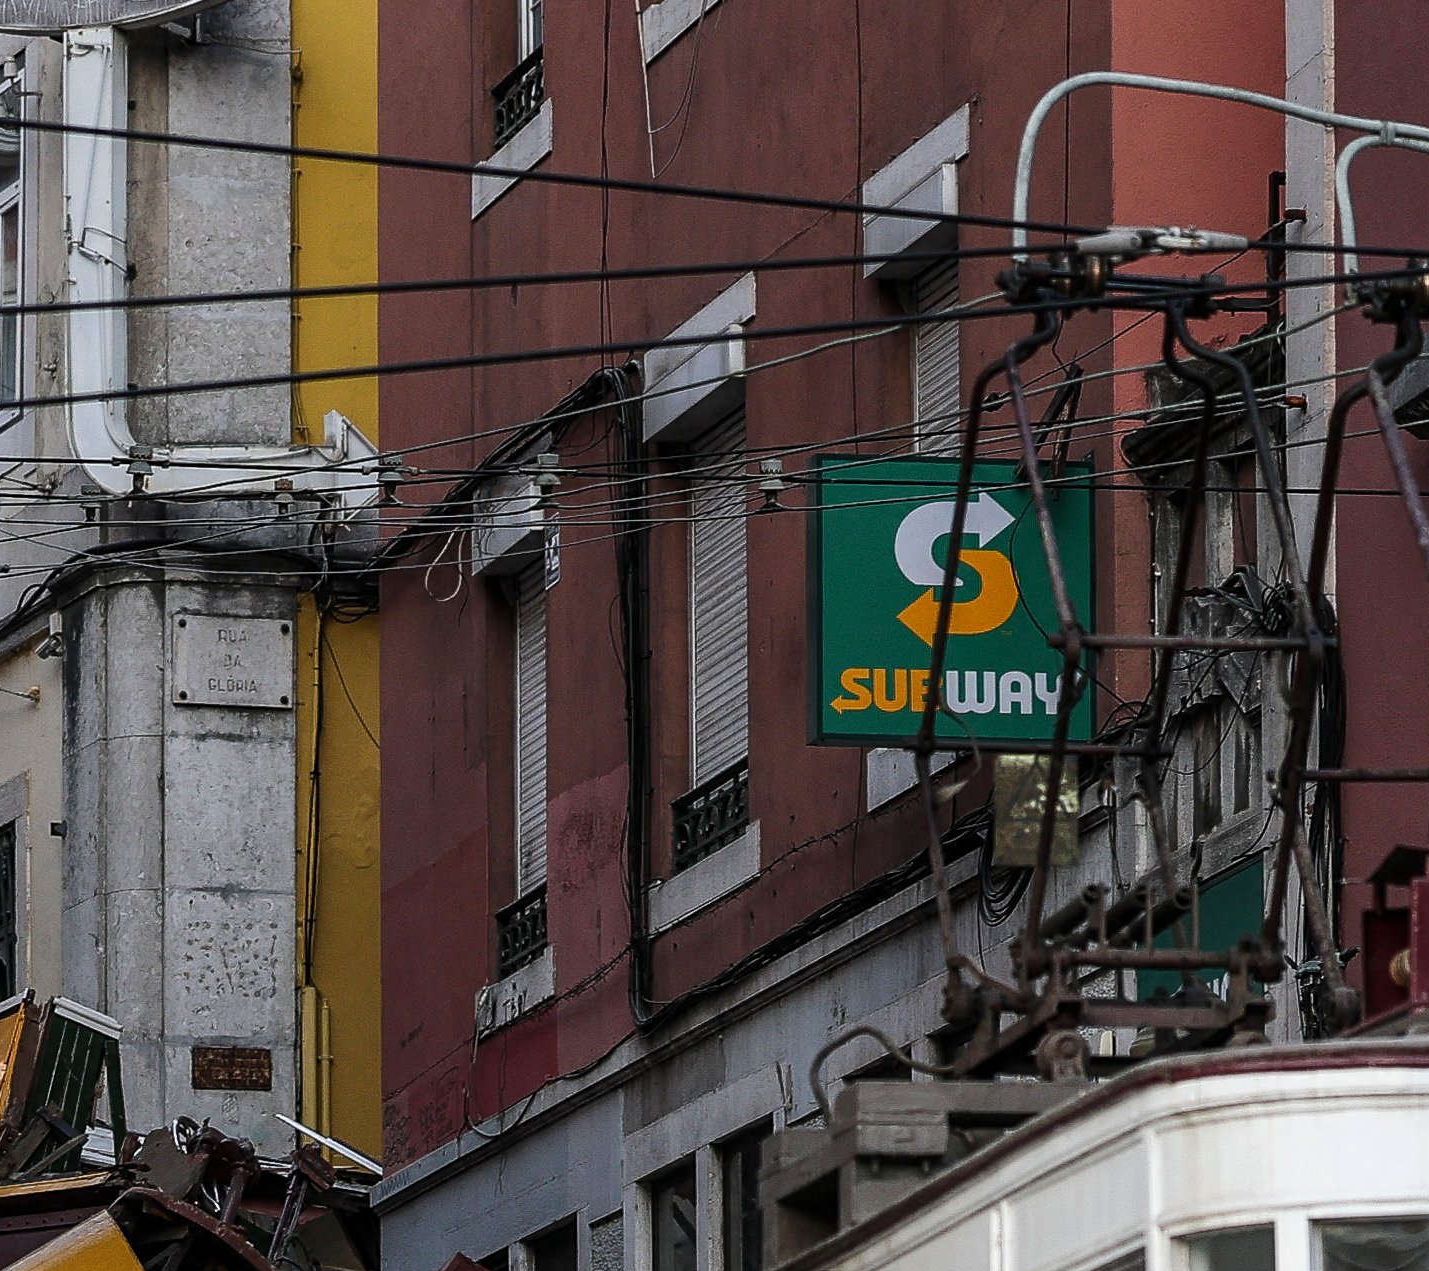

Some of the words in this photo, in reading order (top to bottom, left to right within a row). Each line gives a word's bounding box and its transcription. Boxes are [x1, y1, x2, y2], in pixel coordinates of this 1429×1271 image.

[217, 629, 248, 643] RUA
[207, 675, 258, 694] GLÓRIA
[830, 667, 1083, 715] SUBWAY
